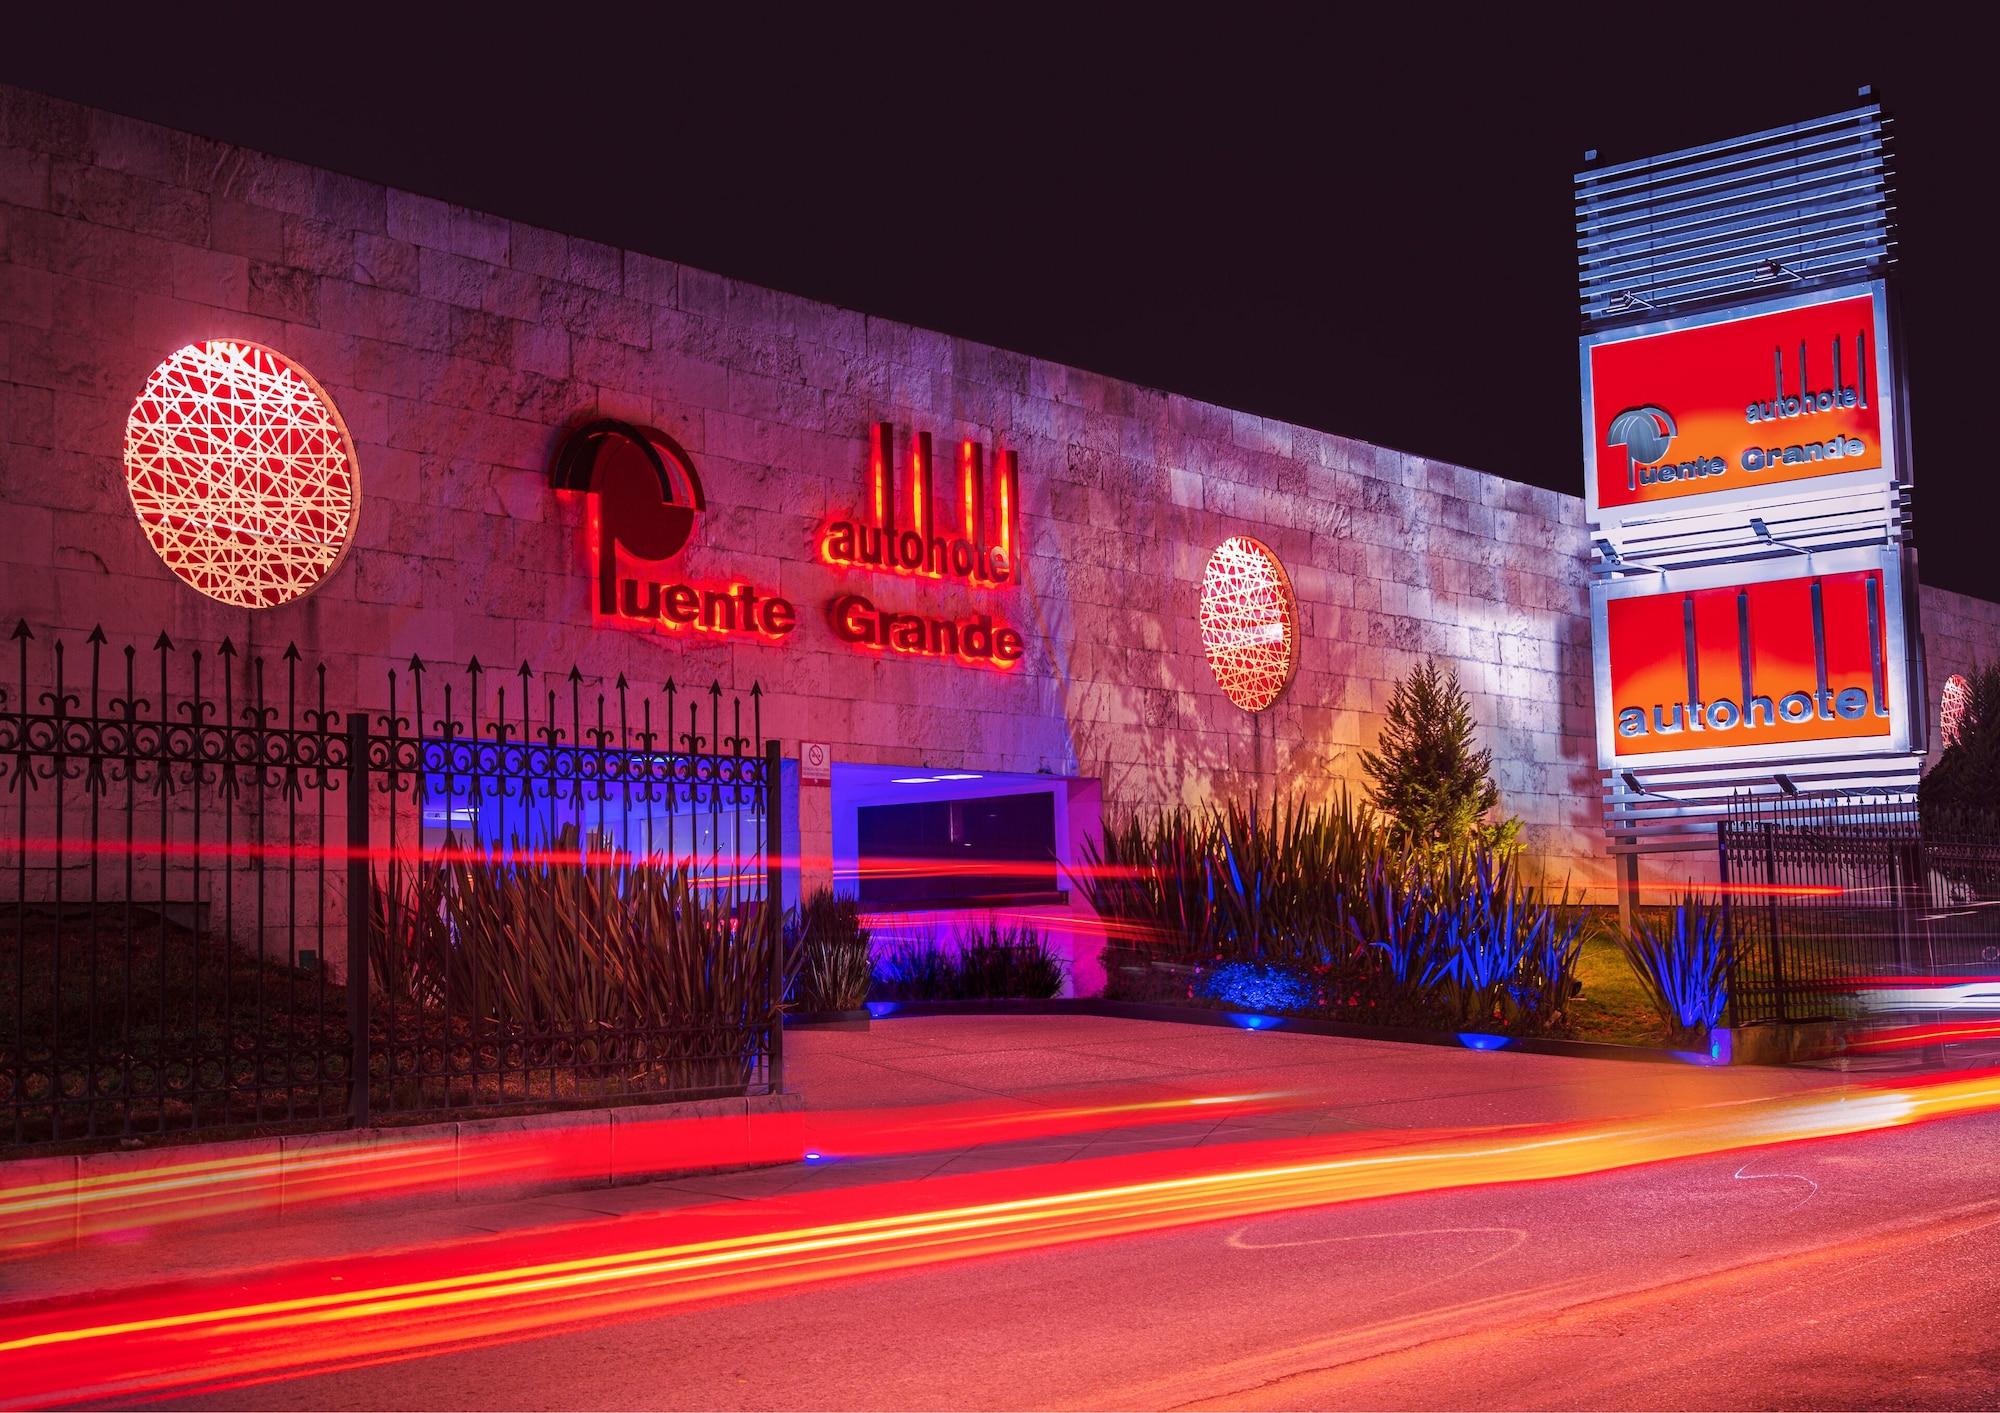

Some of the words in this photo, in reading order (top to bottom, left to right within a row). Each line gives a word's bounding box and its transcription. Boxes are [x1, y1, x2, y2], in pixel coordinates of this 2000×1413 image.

[1607, 404, 1726, 490] Puente
[1741, 435, 1866, 472] Grande
[1746, 330, 1867, 422] autohotel
[549, 418, 796, 635] Puente
[834, 595, 1024, 661] Grande
[828, 422, 1021, 584] autohotel
[1618, 577, 1890, 738] autohotel
